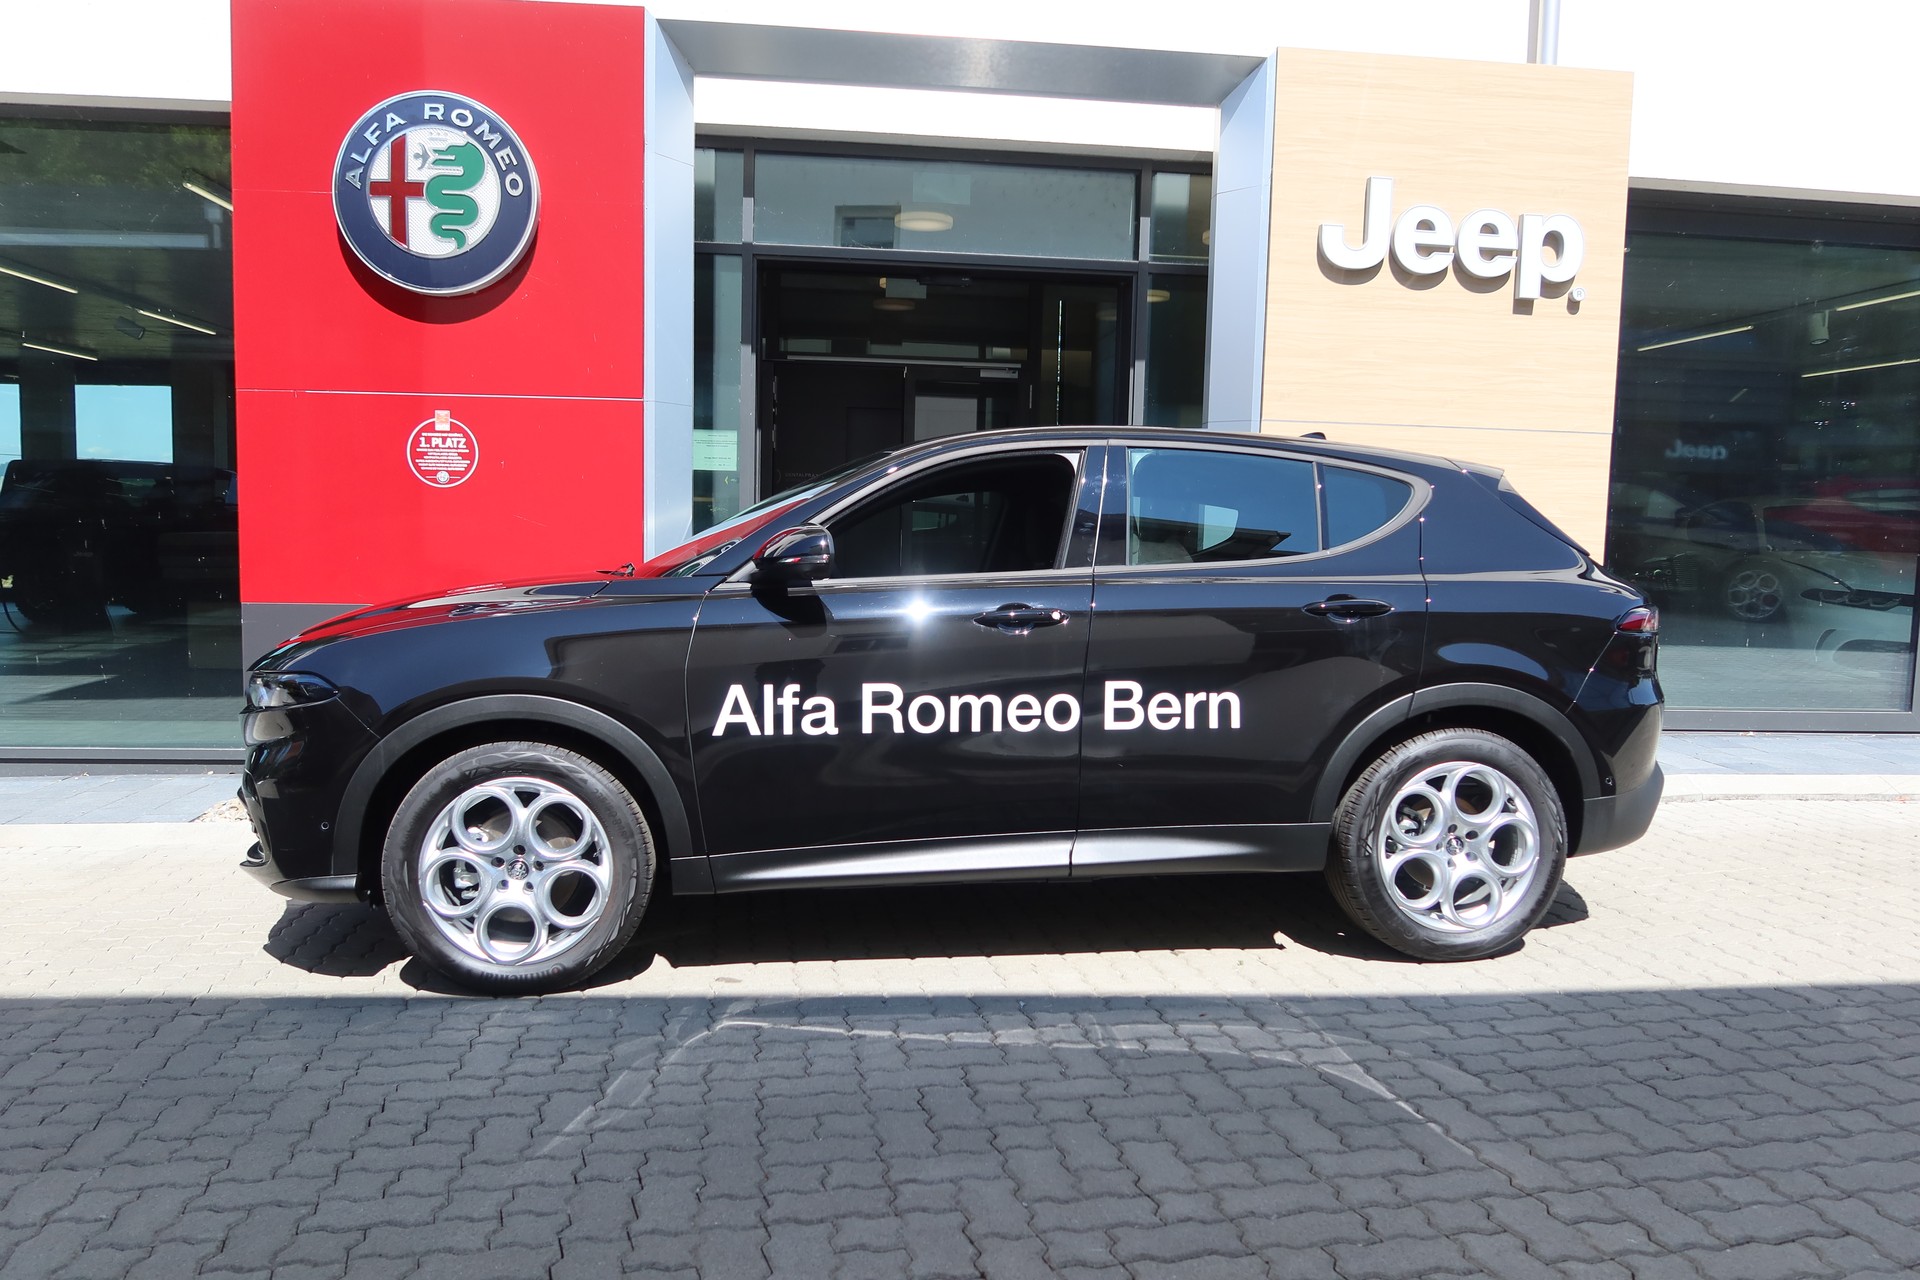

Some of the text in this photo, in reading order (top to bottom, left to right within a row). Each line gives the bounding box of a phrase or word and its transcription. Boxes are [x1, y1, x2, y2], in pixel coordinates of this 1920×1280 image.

[345, 102, 524, 198] ALFA ROMEO
[1318, 176, 1585, 300] Jeep
[419, 437, 467, 449] 1. PLATZ
[712, 681, 1240, 736] Alfa Romeo Bern
